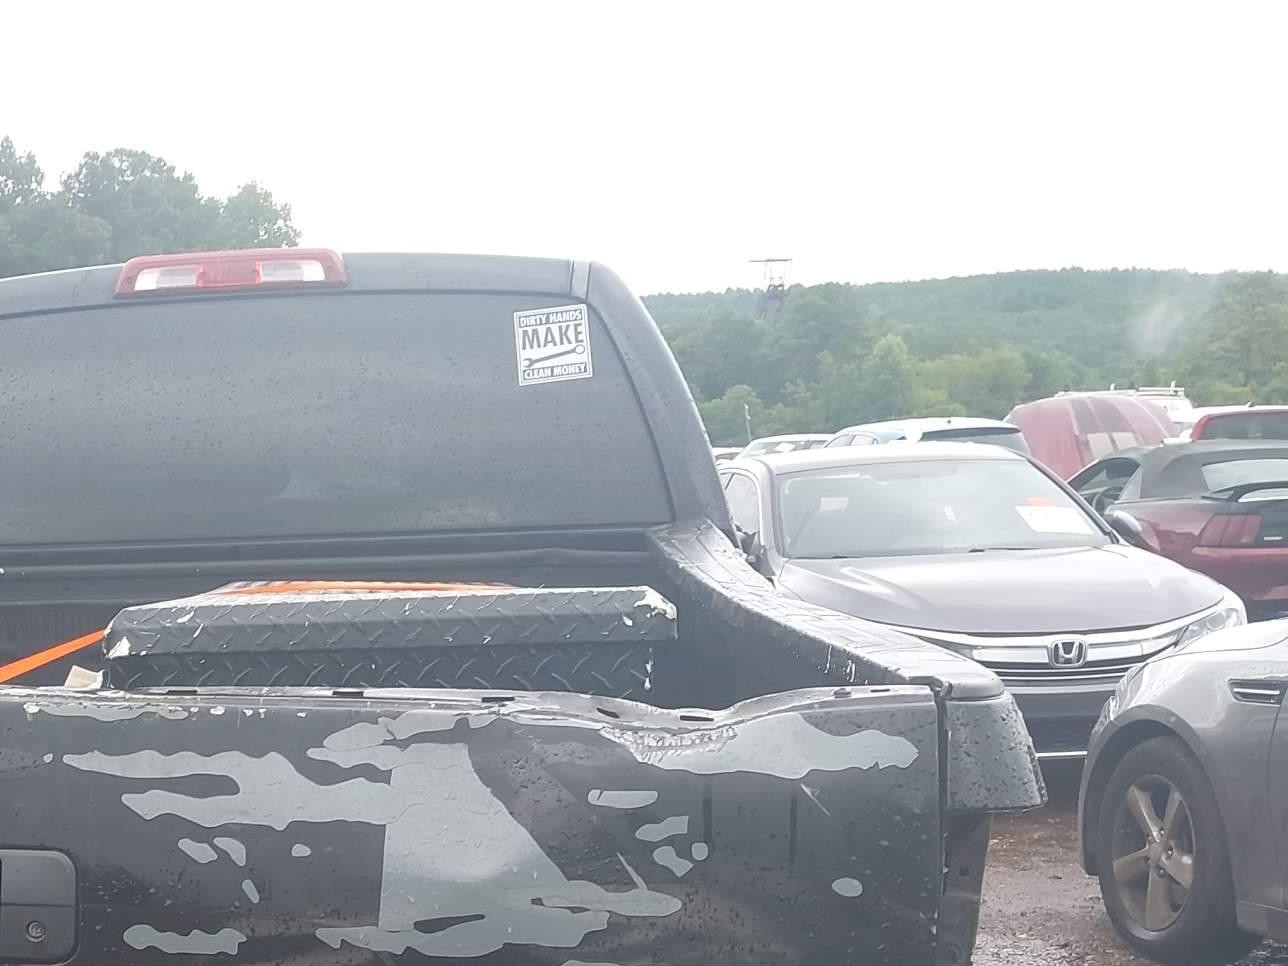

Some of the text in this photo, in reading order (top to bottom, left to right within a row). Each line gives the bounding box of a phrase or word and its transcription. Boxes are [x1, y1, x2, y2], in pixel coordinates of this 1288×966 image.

[520, 309, 582, 327] DIRTY HANDS
[522, 323, 584, 350] MAKE
[524, 362, 586, 379] CLEAN MONEY
